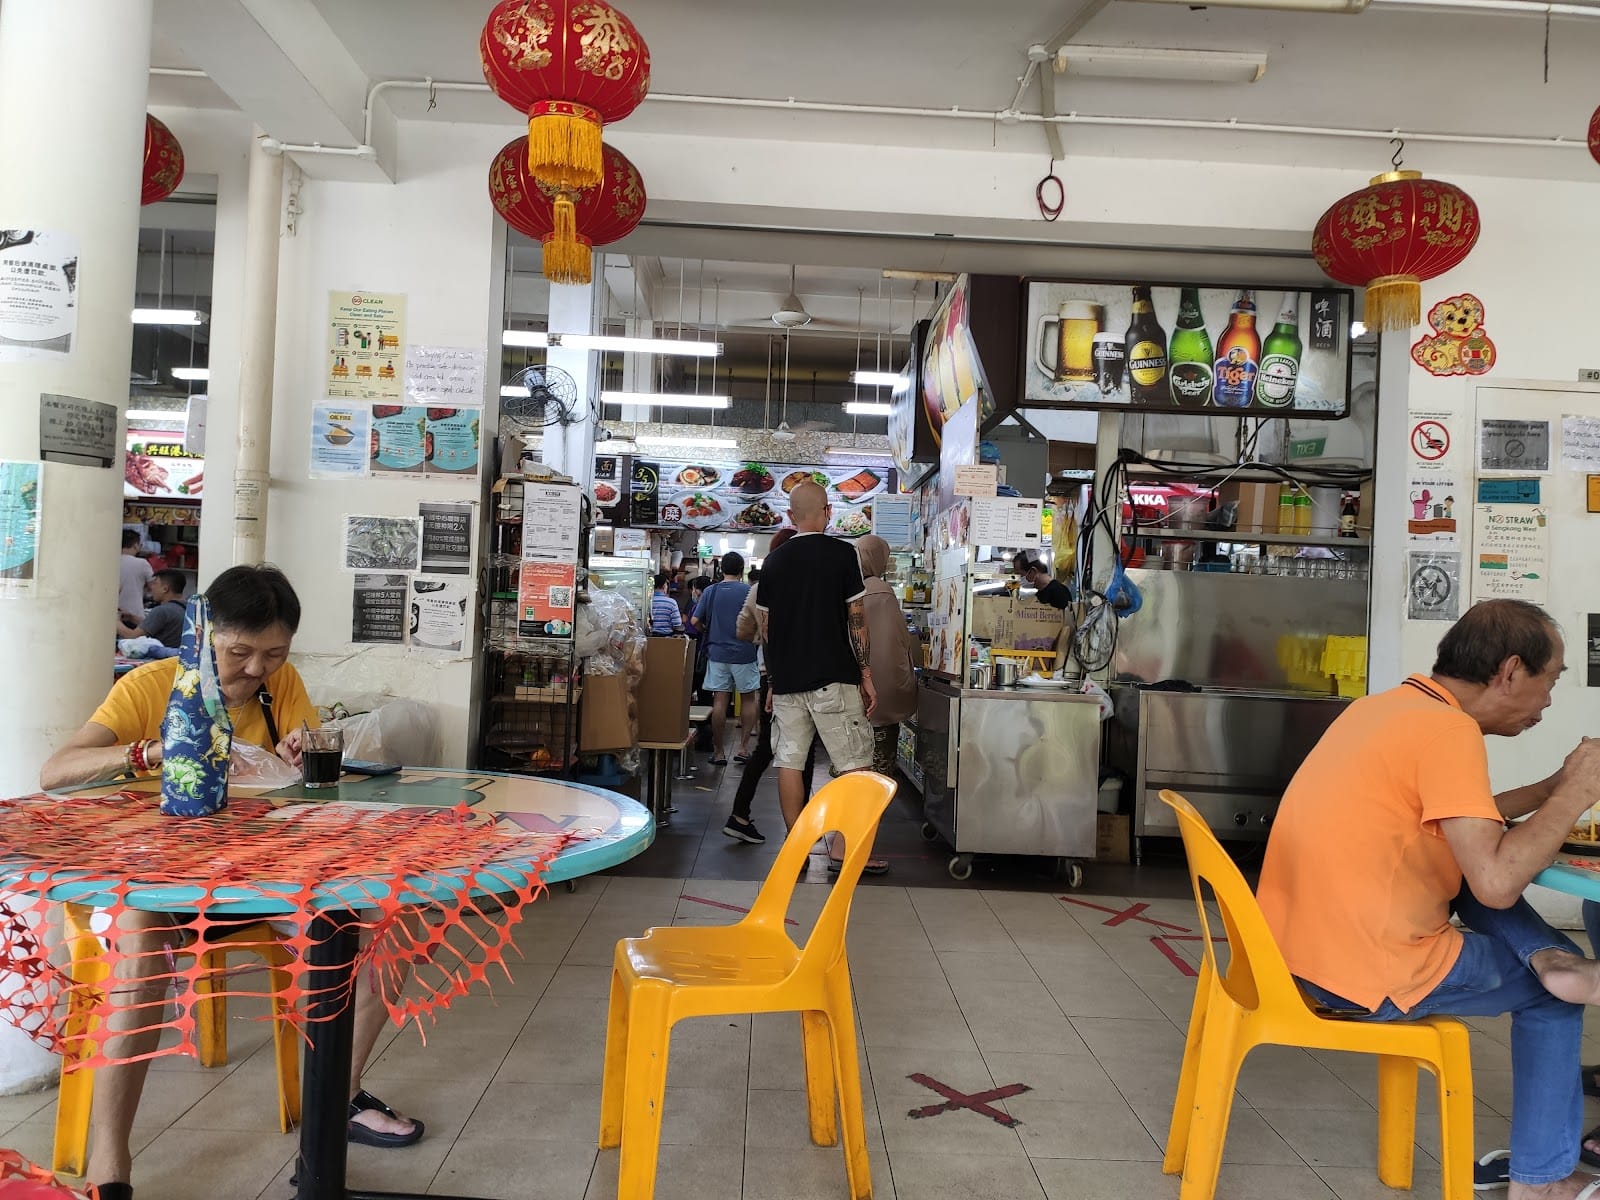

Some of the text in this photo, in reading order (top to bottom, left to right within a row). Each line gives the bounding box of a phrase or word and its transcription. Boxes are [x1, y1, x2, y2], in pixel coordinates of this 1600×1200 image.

[1315, 298, 1334, 339] 啤酒
[1094, 349, 1124, 359] GUINNESS
[1128, 358, 1166, 370] GUINNESS
[1173, 374, 1210, 388] Carlsberg
[1218, 366, 1255, 386] Tiger
[1260, 373, 1296, 386] Heineken
[1505, 516, 1534, 525] STRAW
[1016, 610, 1062, 620] Mixed Berries
